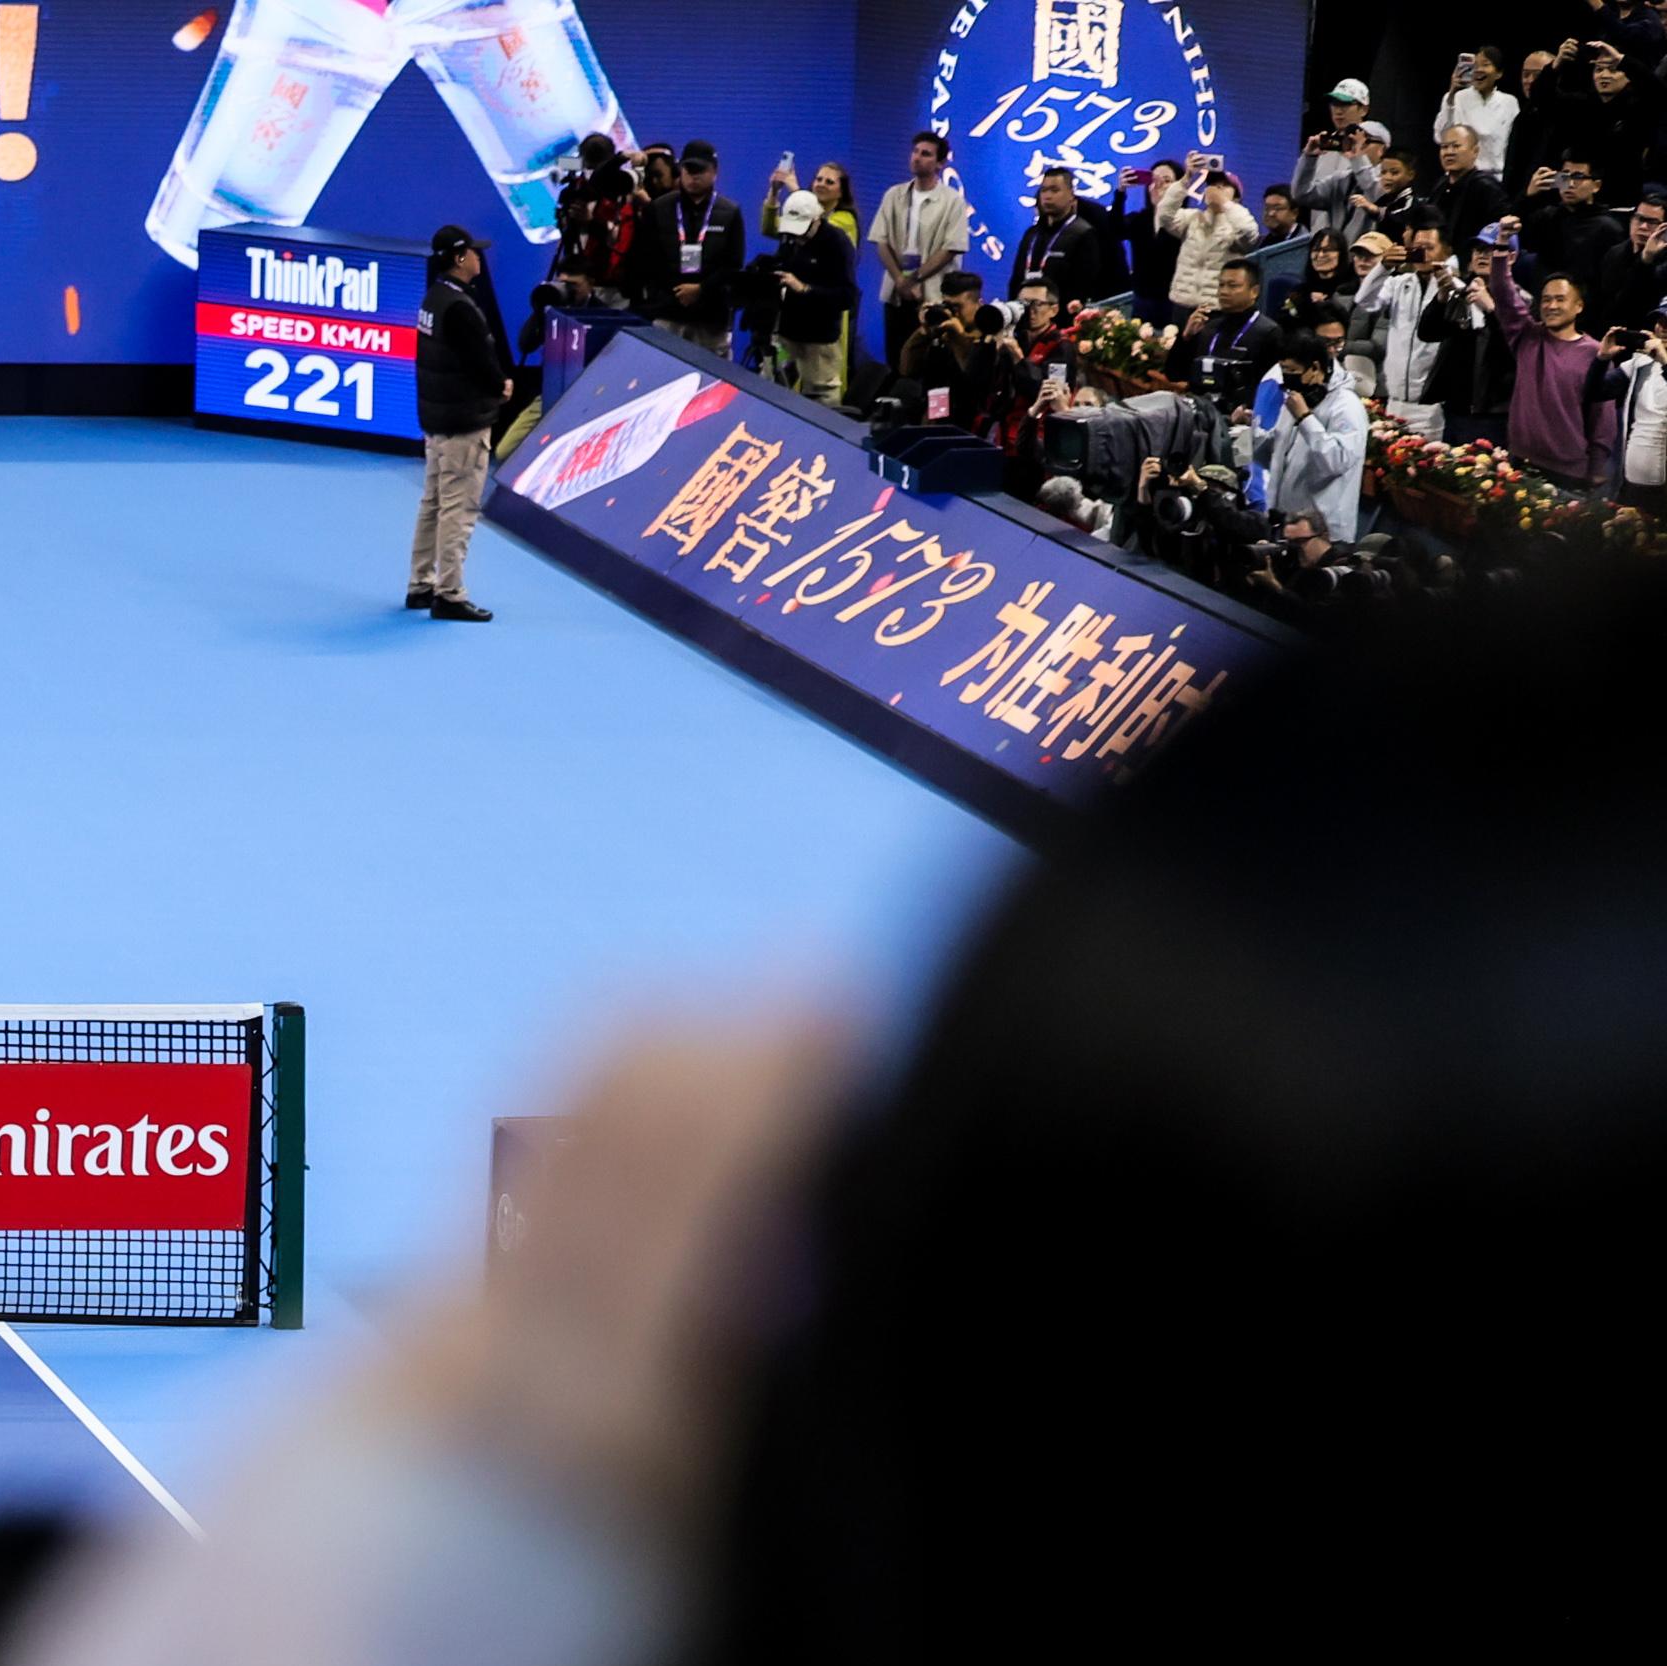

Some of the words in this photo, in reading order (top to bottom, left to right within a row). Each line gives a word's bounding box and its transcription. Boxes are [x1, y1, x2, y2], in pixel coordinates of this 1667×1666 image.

[1147, 0, 1218, 147] CHIN
[968, 84, 1178, 155] 1573
[245, 246, 379, 313] ThinkPad
[229, 311, 316, 343] SPEED
[320, 322, 392, 353] KM/H
[243, 347, 375, 421] 221
[761, 509, 998, 648] 1573
